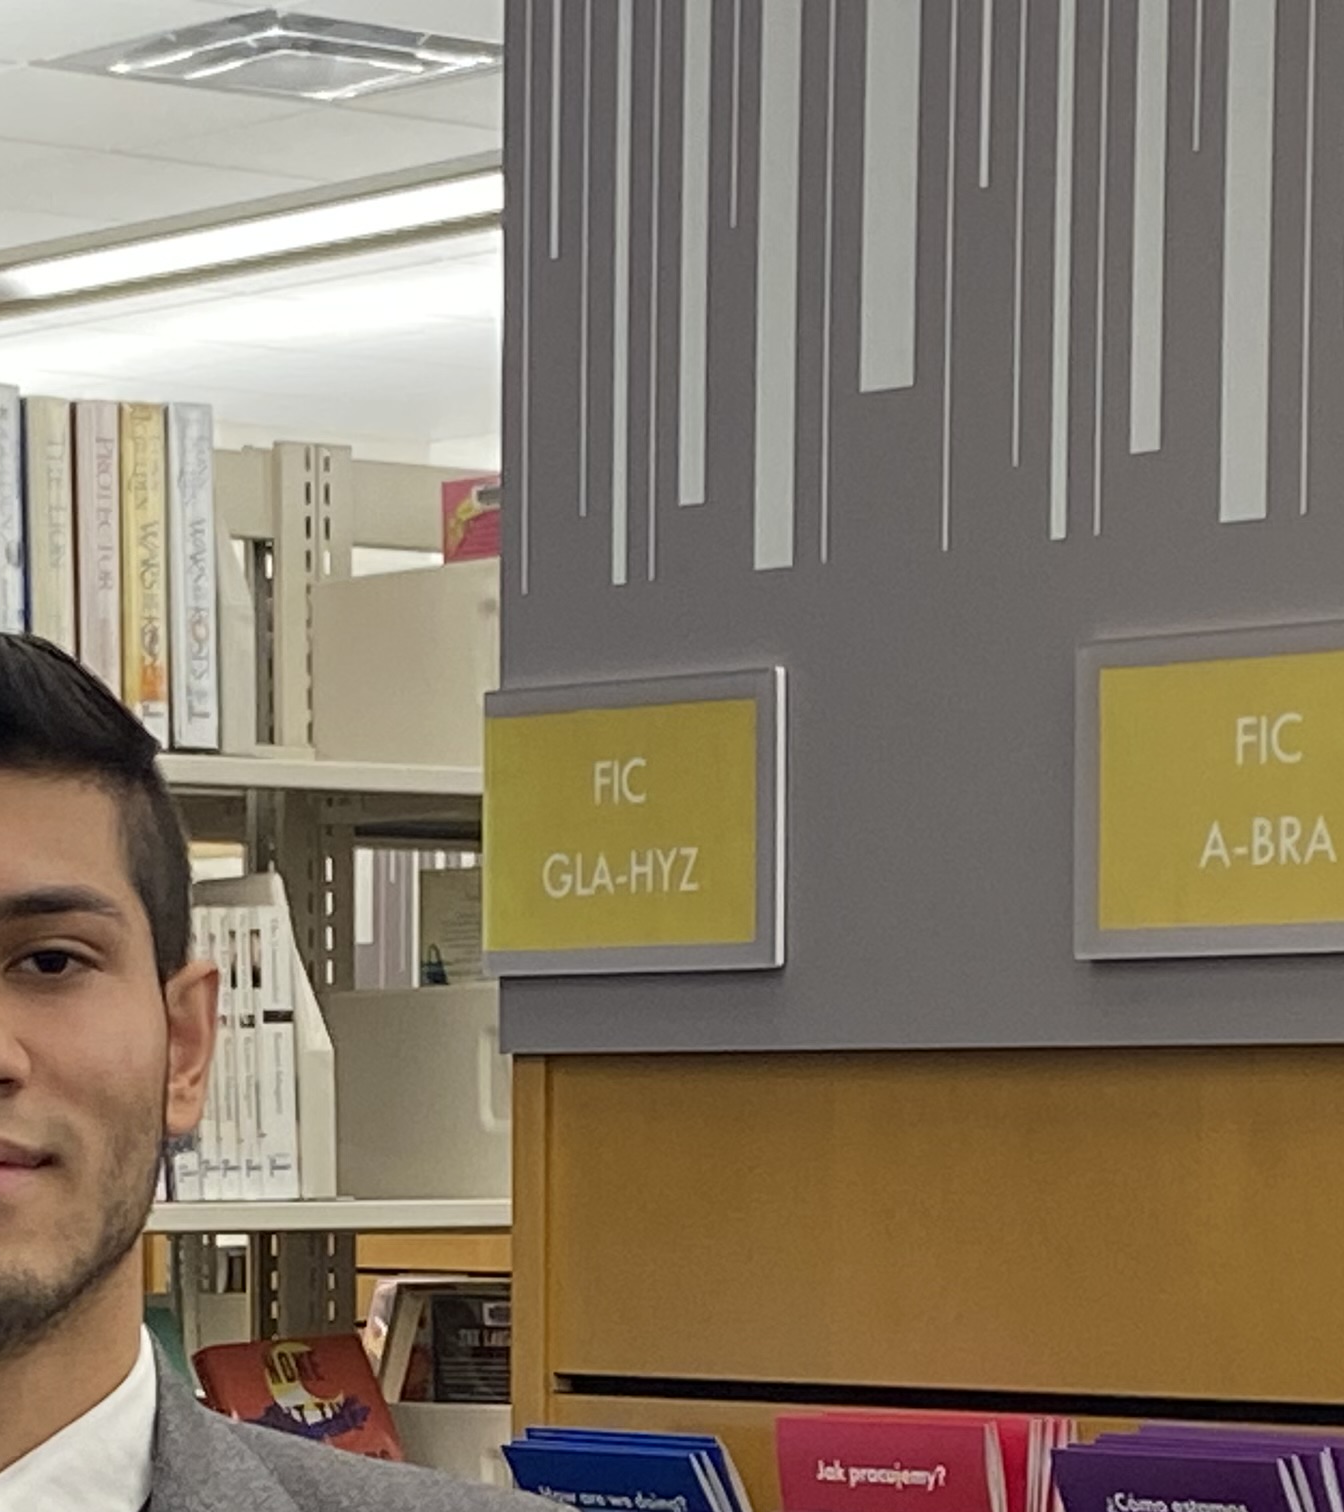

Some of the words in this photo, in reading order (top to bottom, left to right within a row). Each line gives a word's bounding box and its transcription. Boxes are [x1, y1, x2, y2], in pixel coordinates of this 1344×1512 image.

[95, 435, 114, 592] PROTECTOR
[1234, 711, 1304, 768] FIC
[592, 756, 648, 806] FIC
[1197, 814, 1338, 872] A-BRA
[541, 843, 702, 901] GLA-HYZ
[816, 1459, 846, 1484] Jak
